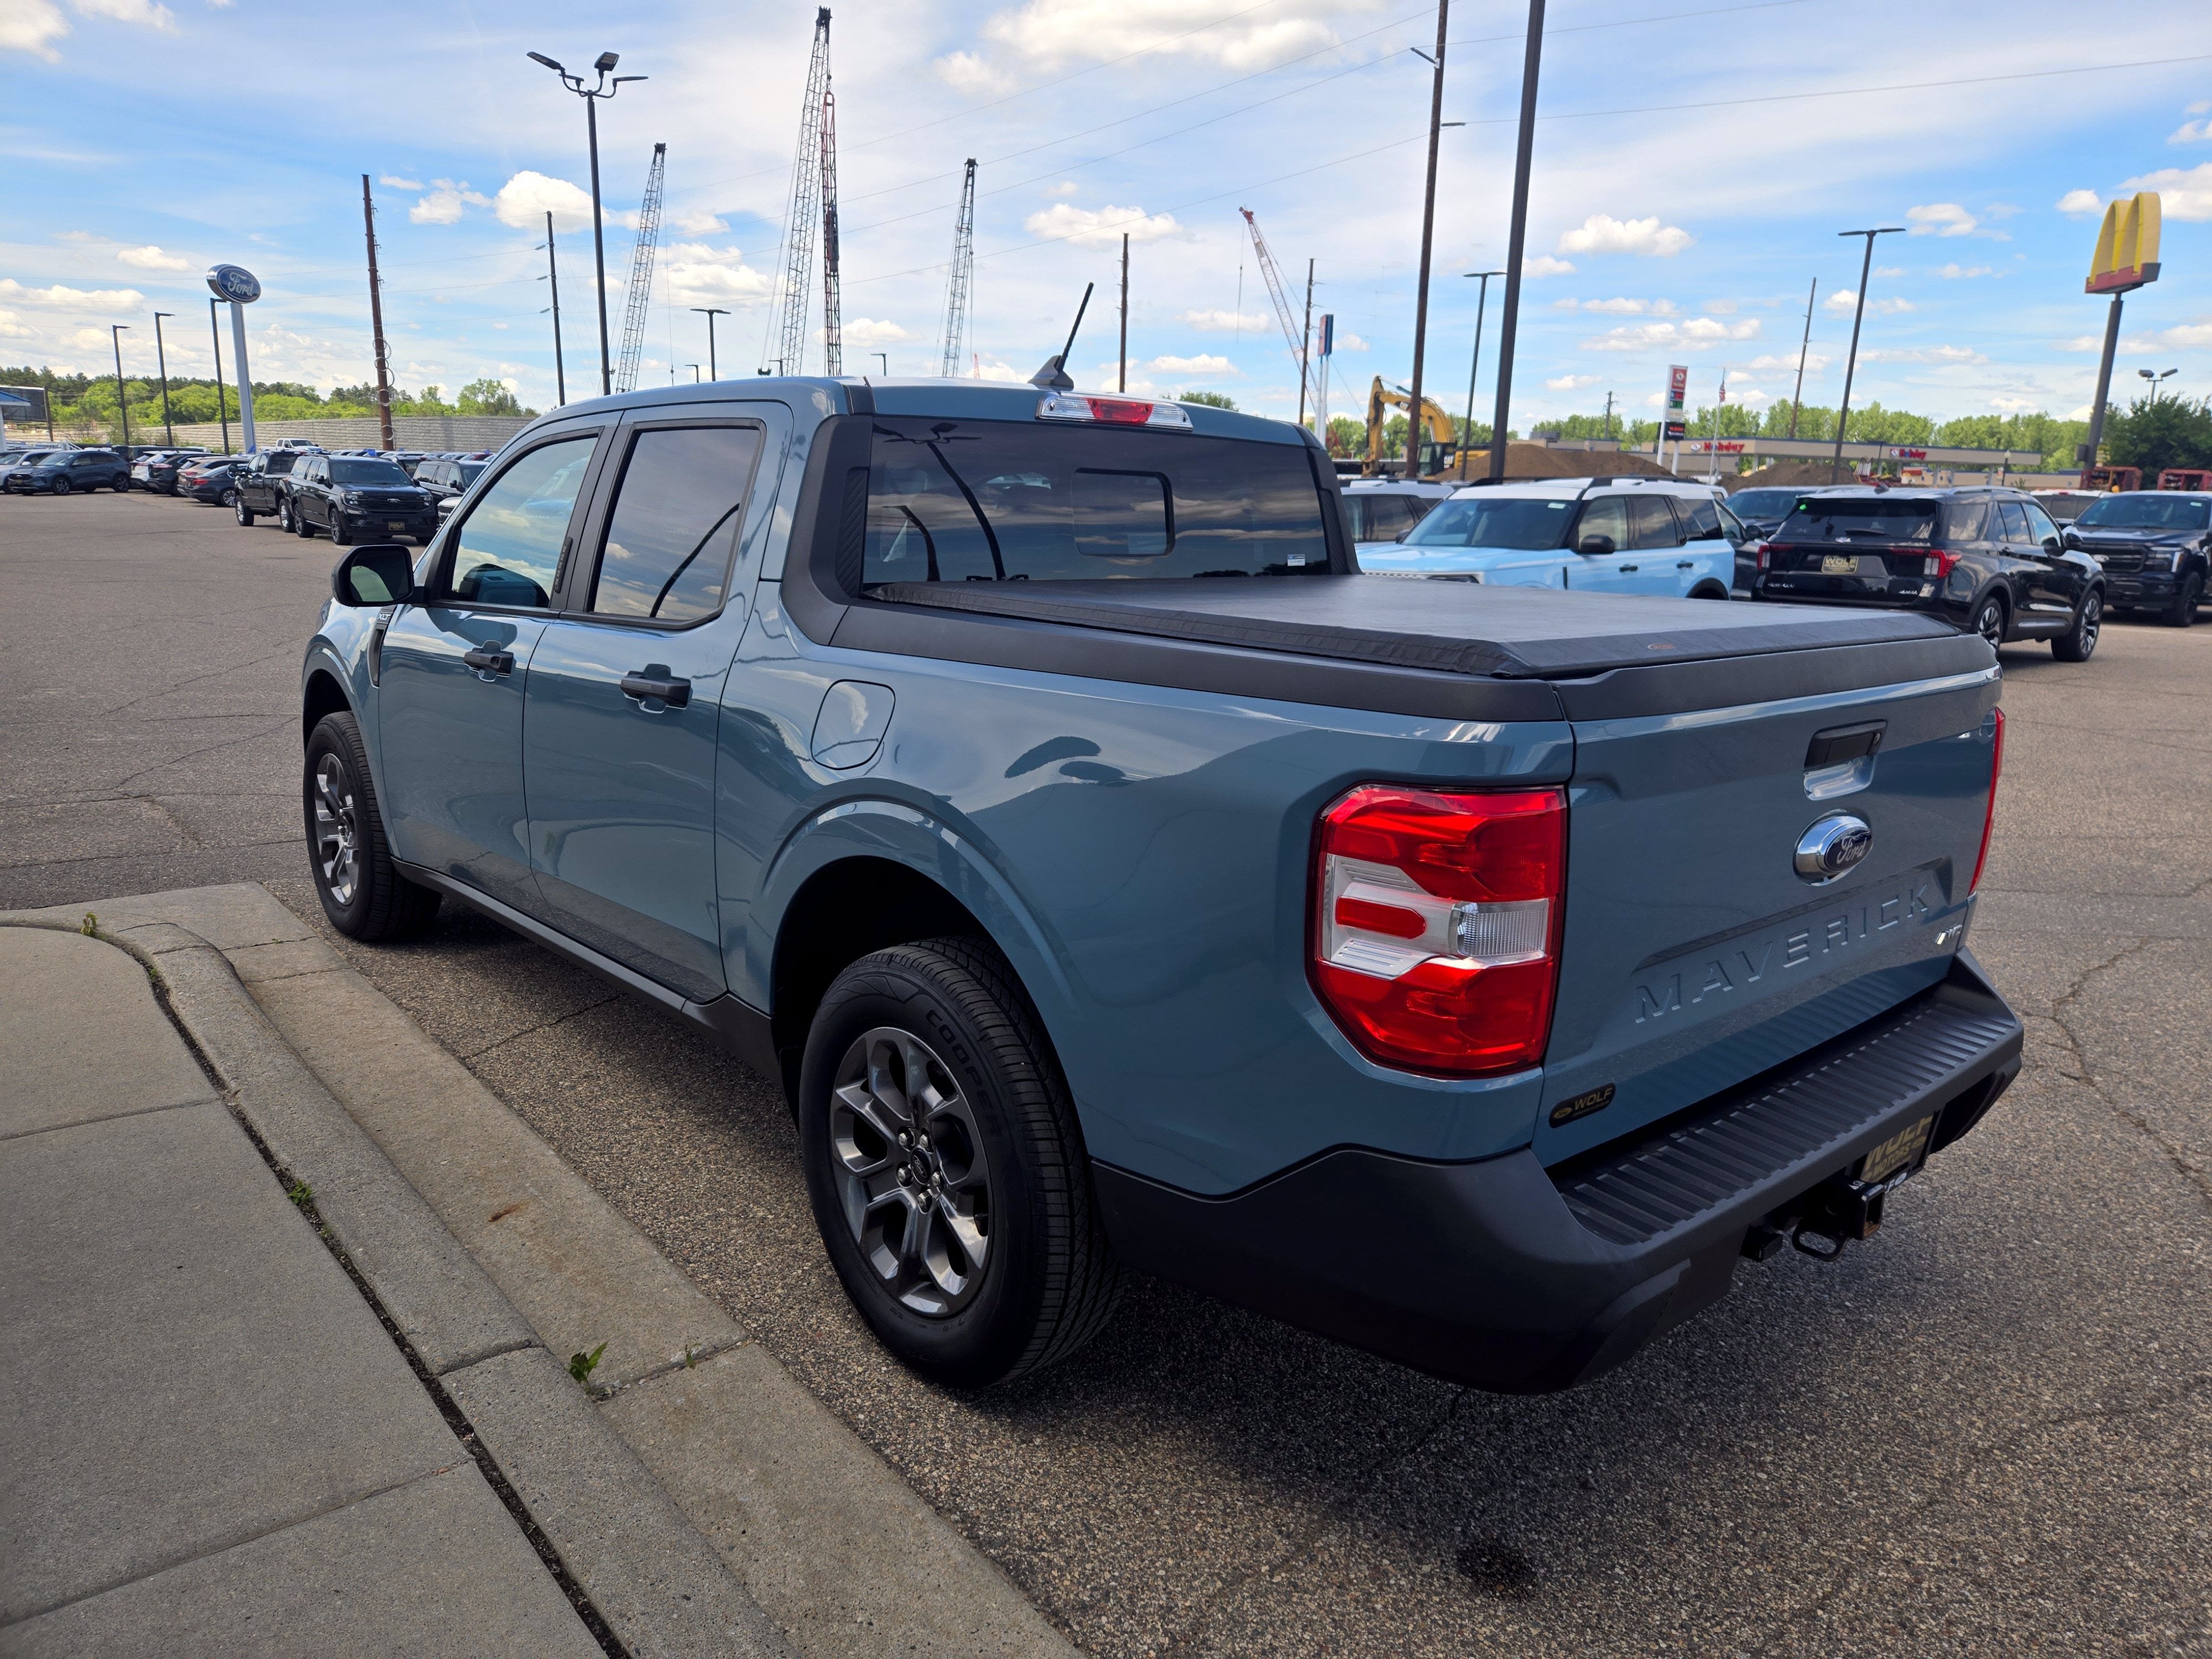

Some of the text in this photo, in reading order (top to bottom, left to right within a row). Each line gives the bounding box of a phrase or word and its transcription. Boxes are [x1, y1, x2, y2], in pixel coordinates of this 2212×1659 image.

[228, 272, 254, 296] Ford
[1444, 456, 1454, 464] CAT
[1837, 831, 1870, 864] Ford
[1635, 884, 1929, 1023] MAVERICK
[925, 1009, 1002, 1138] COOPER
[1574, 1087, 1613, 1111] WOLF
[1873, 1142, 1912, 1177] MOTORS
